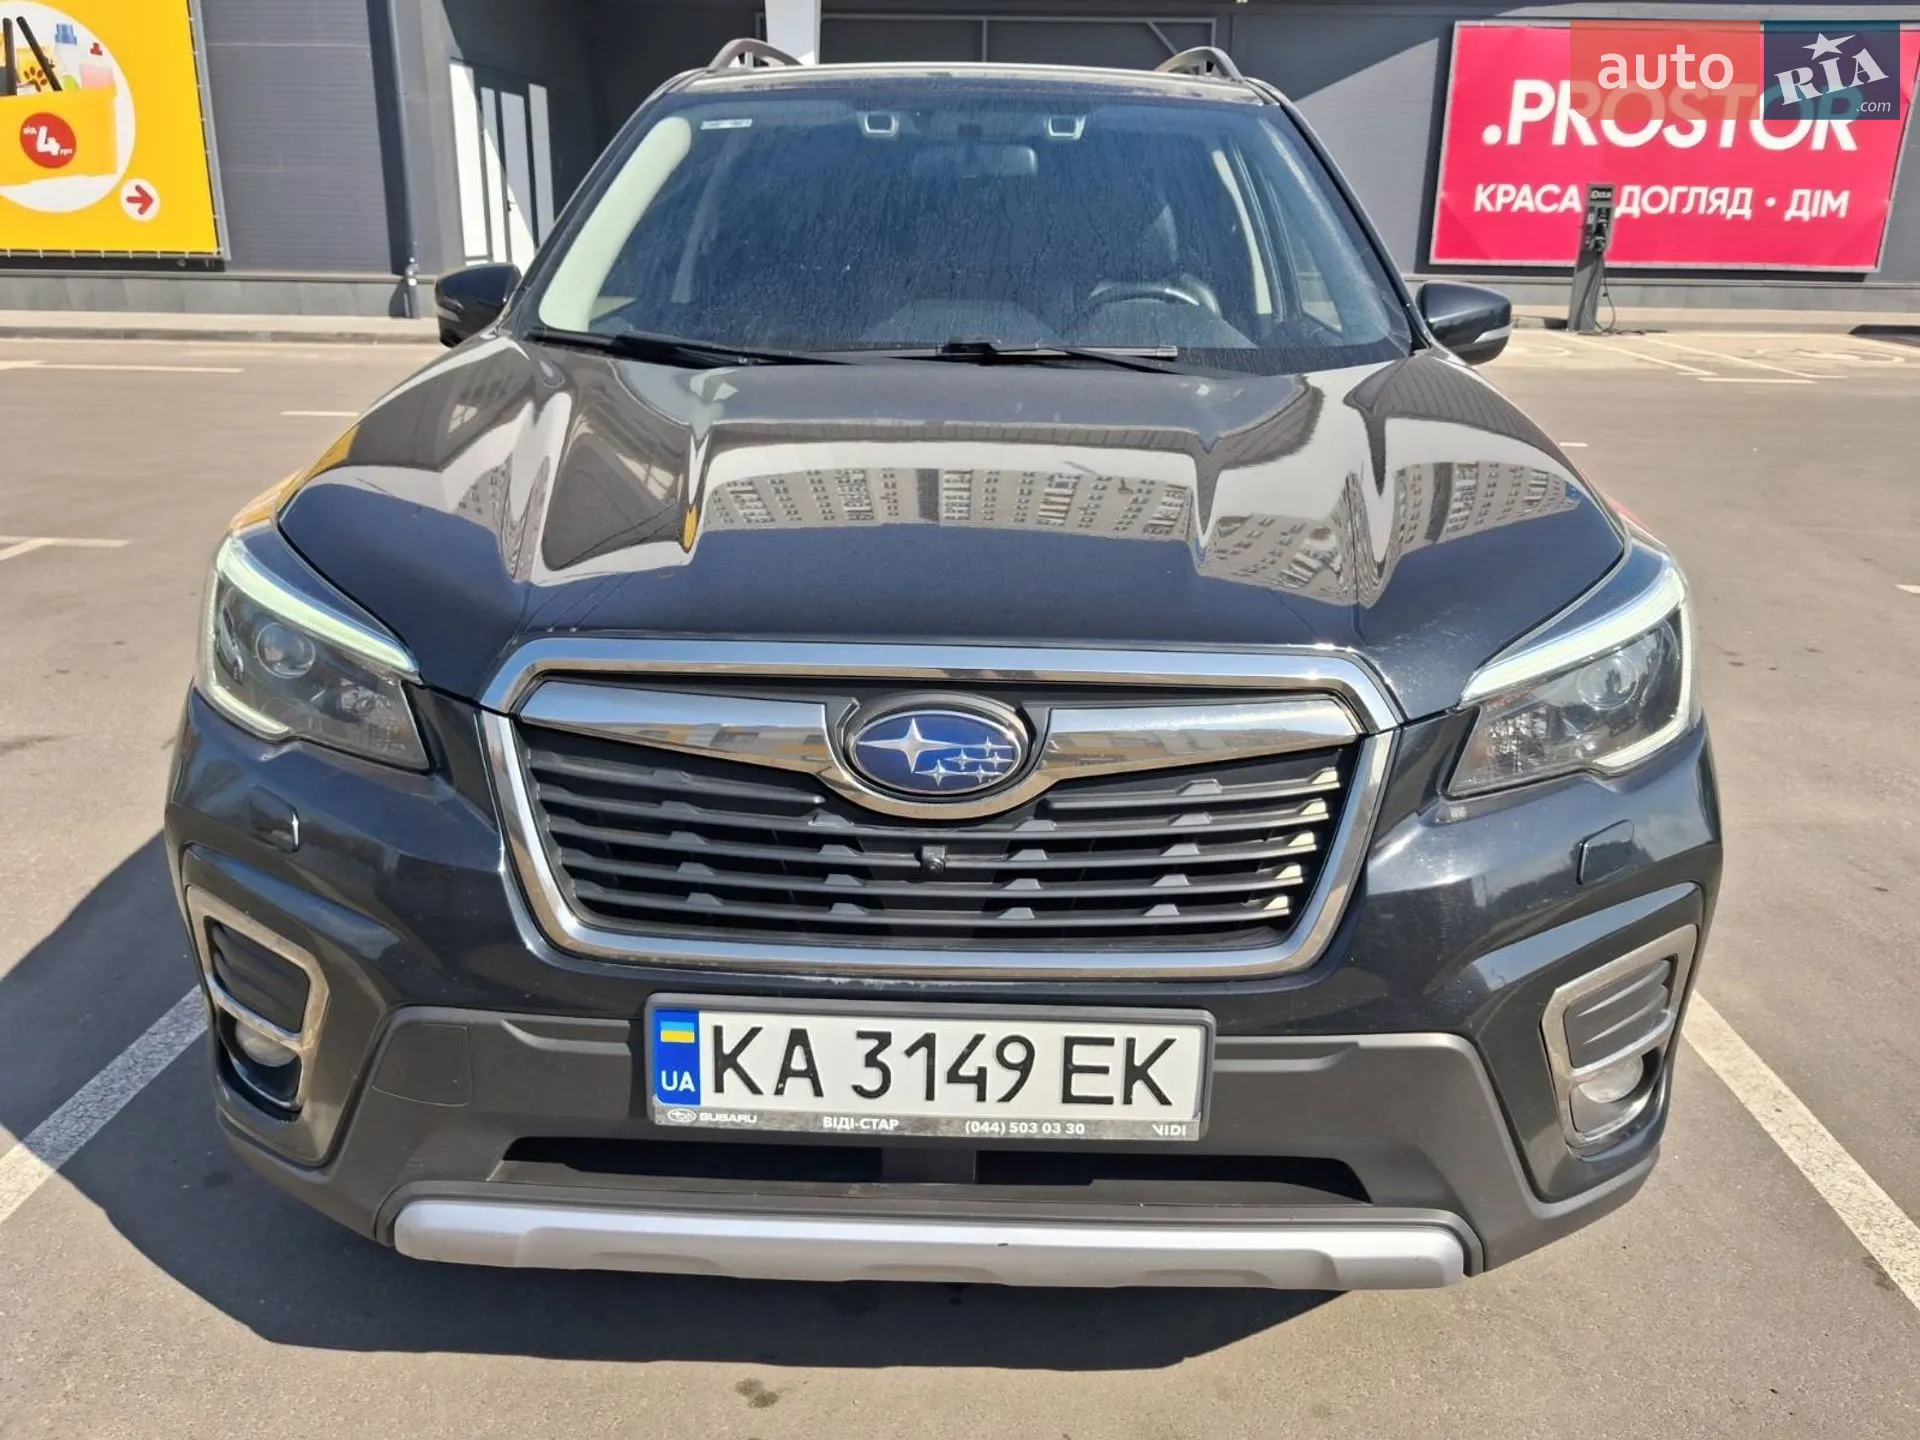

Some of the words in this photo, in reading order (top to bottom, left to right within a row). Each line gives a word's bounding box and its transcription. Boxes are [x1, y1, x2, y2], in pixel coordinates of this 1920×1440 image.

[36, 125, 60, 156] 4
[1474, 184, 1582, 213] КРАСА
[1614, 185, 1753, 220] ДОГЛЯД
[1784, 189, 1850, 220] ДІМ
[851, 1030, 1036, 1102] 3149
[661, 1070, 696, 1093] UA
[699, 1112, 758, 1124] SUBARU
[822, 1116, 900, 1131] ВІДІ-СТАР
[964, 1120, 1006, 1135] (044)
[1009, 1122, 1038, 1134] 503
[1042, 1122, 1062, 1135] 03
[1065, 1123, 1085, 1136] 30
